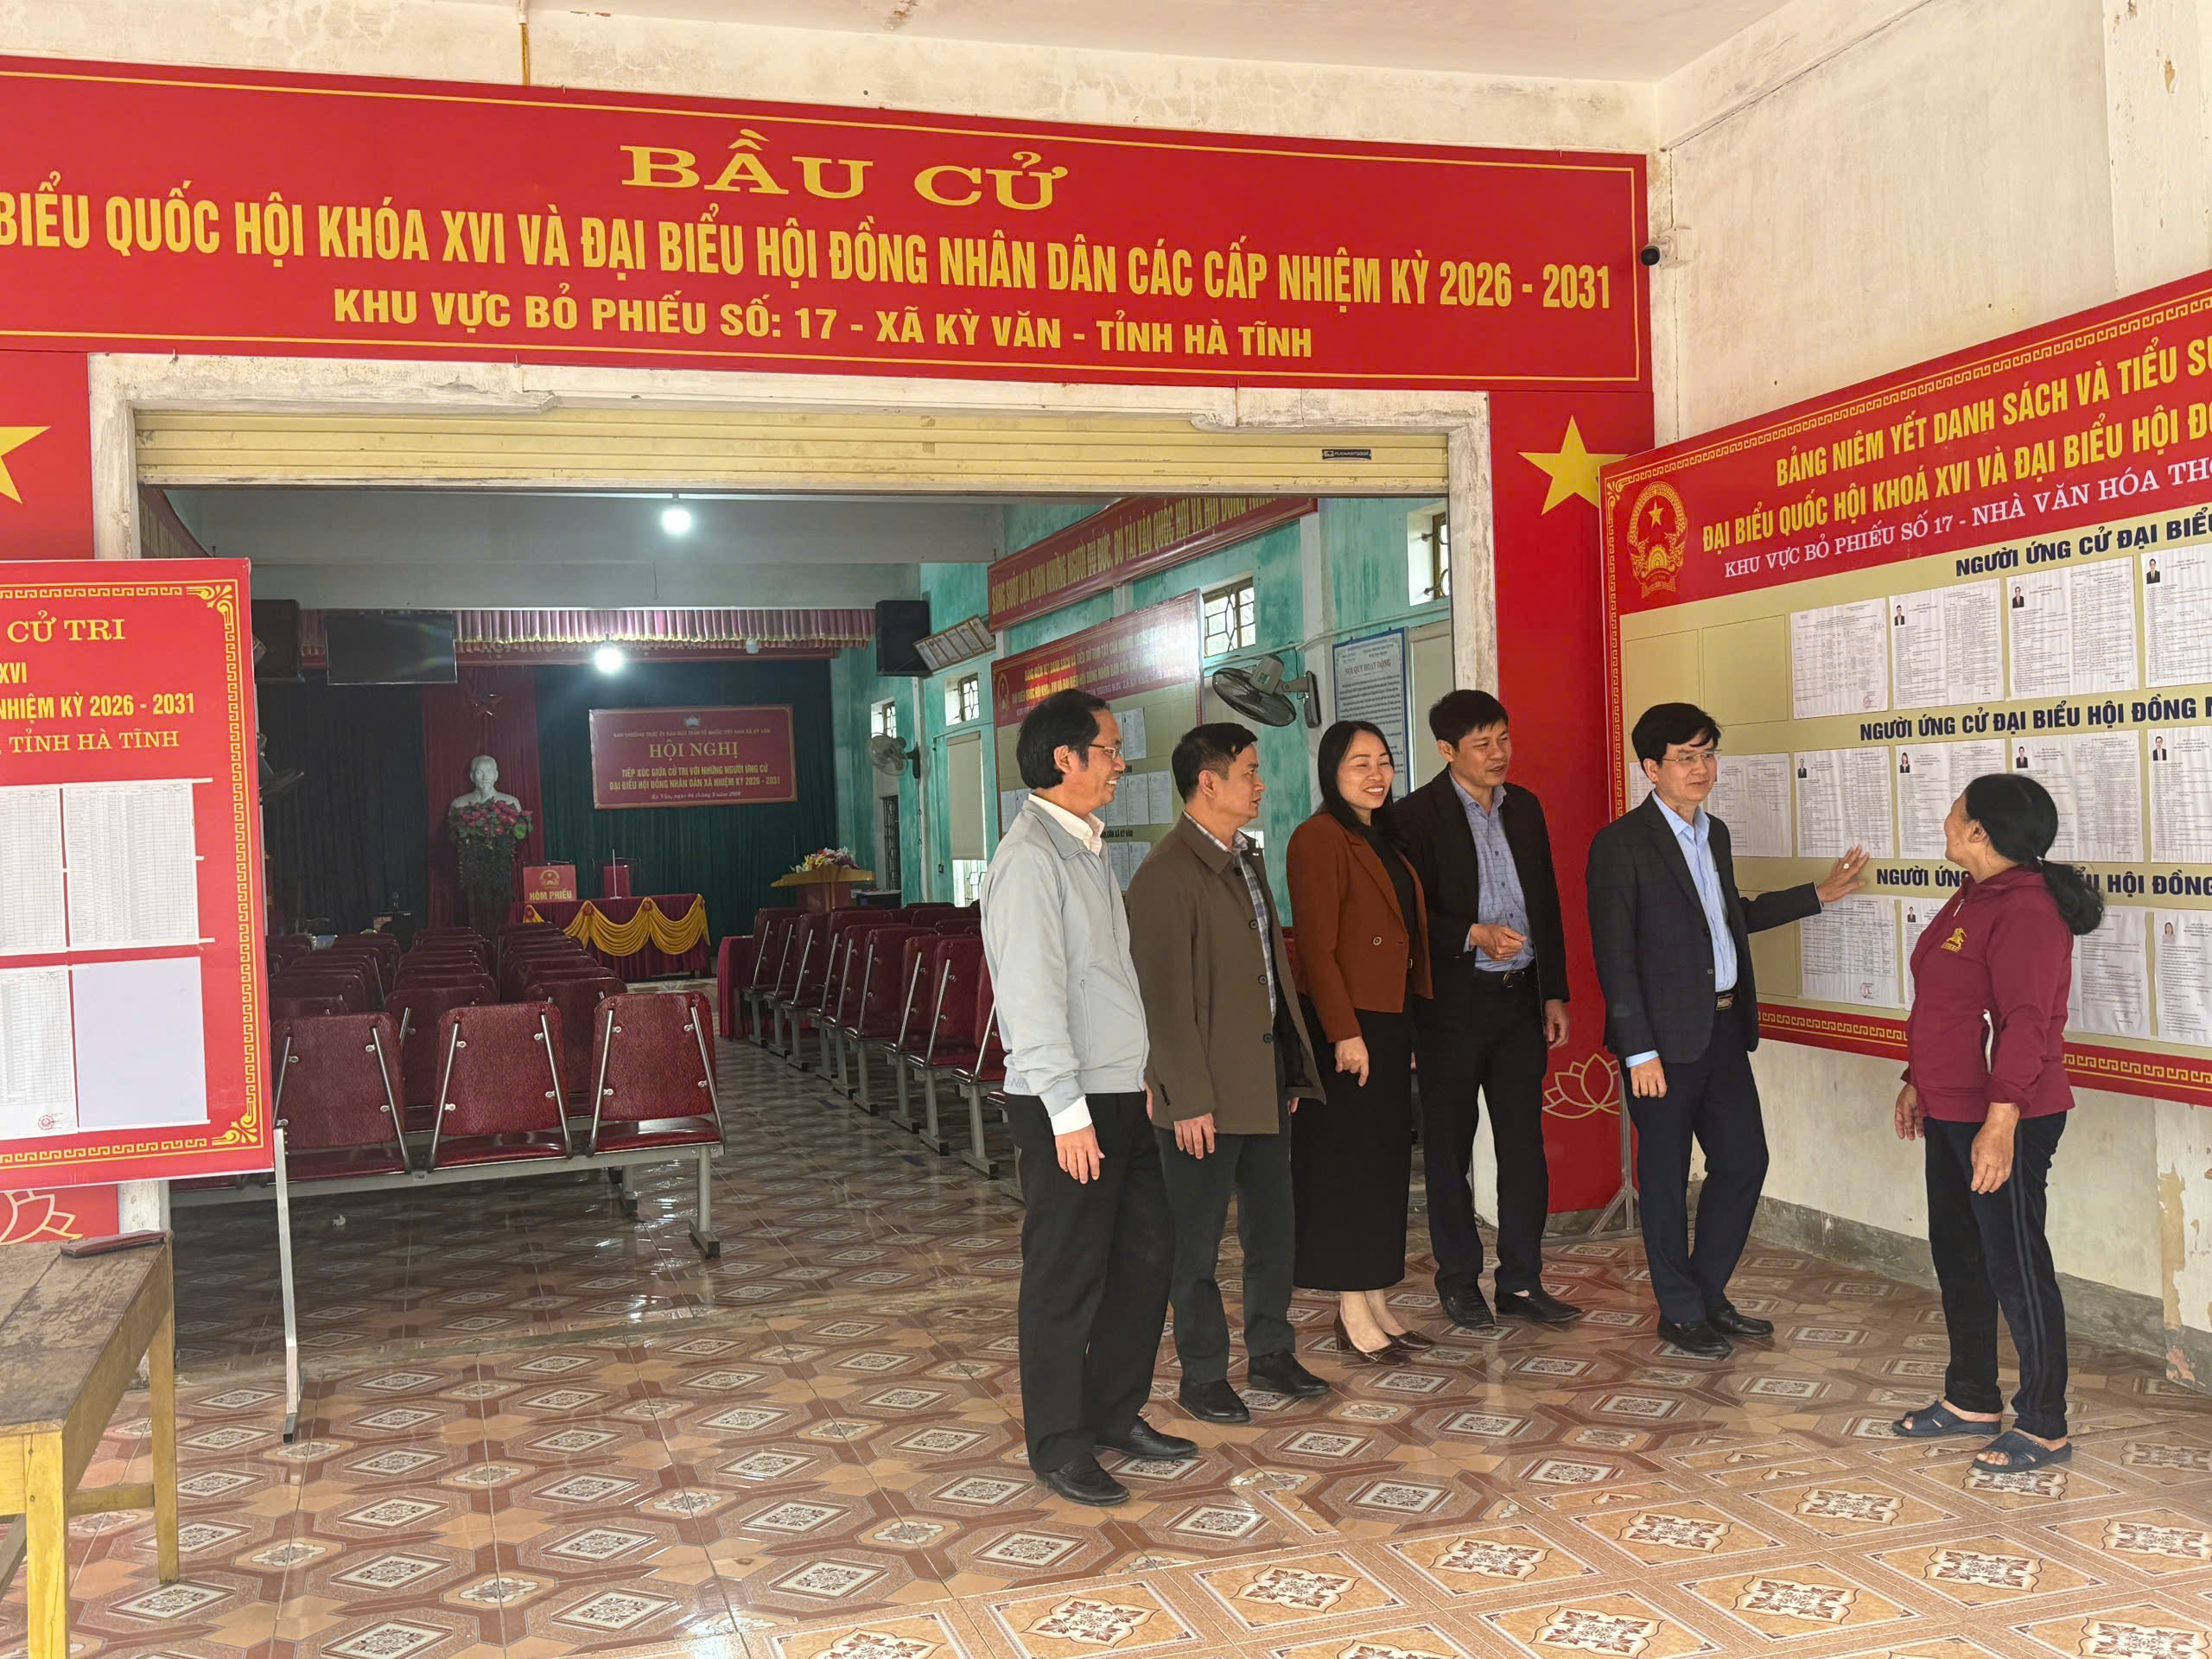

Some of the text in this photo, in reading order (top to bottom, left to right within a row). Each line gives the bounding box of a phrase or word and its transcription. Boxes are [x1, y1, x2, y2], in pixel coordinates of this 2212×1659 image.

[620, 130, 1067, 209] BẦU CỬ
[0, 171, 89, 248] BIỂU
[106, 181, 219, 256] QUỐC
[235, 193, 303, 267] HỘI
[319, 197, 429, 260] KHÓA
[442, 211, 505, 263] XVI
[518, 205, 569, 266] VÀ
[581, 218, 645, 280] ĐẠI
[659, 203, 743, 275] BIỂU
[757, 218, 817, 288] HỘI
[830, 216, 927, 283] ĐỒNG
[940, 230, 1035, 288] NHÂN
[1048, 234, 1116, 292] DÂN
[1128, 238, 1192, 296] CÁC
[1205, 236, 1267, 298] CẤP
[1279, 247, 1380, 312] NHIỆM
[1392, 251, 1428, 303] KỲ
[1440, 261, 1511, 306] 2026
[1544, 264, 1608, 308] 2031
[334, 289, 416, 323] KHU
[431, 290, 510, 333] VỰC
[525, 283, 577, 329] BỎ
[593, 290, 705, 334] PHIẾU
[721, 295, 780, 337] SỐ:
[795, 308, 836, 339] 17
[876, 306, 924, 342] XÃ
[937, 308, 979, 345] KỲ
[992, 311, 1060, 347] VĂN
[1096, 310, 1172, 353] TỈNH
[1185, 320, 1228, 354] HÀ
[1238, 321, 1311, 357] TĨNH
[1777, 336, 2212, 486] BẢNG NIÊM YẾT DANH SÁCH VÀ TIỂU S
[1703, 522, 1729, 554] ĐẠI
[1736, 502, 1773, 543] BIỂU
[1780, 495, 1827, 536] QUỐC
[1834, 483, 1866, 524] HỘI
[1873, 466, 1929, 512] KHOÁ
[1936, 461, 1970, 497] XVI
[1978, 453, 2007, 486] VÀ
[2014, 440, 2055, 482] ĐẠI
[2064, 413, 2122, 468] BIỂU
[2133, 405, 2177, 454] HỘI
[1726, 556, 1759, 577] KHU
[1766, 547, 1799, 568] VỰC
[1805, 534, 1828, 561] BỎ
[1835, 525, 1894, 554] PHIẾU
[1902, 515, 1928, 540] SỐ
[1935, 516, 1953, 533] 17
[1972, 493, 2025, 525] NHÀ
[2033, 477, 2089, 512] VĂN
[2099, 467, 2159, 500] HÓA
[2168, 458, 2212, 485] TH
[1956, 547, 2018, 576] NGƯỜI
[2026, 541, 2070, 563] ỨNG
[2080, 526, 2112, 555] CỬ
[2117, 524, 2157, 549] ĐẠI
[8, 610, 125, 643] CỬ TRI
[60, 691, 83, 717] KỲ
[90, 695, 134, 716] 2026
[153, 693, 194, 715] 2031
[1860, 716, 1912, 741] NGƯỜI
[1919, 714, 1955, 736] ỨNG
[1962, 707, 1989, 733] CỬ
[1993, 712, 2025, 734] ĐẠI
[2033, 701, 2080, 728] BIỂU
[2088, 701, 2124, 728] HỘI
[2132, 694, 2196, 721] ĐỒNG
[9, 728, 179, 753] TỈNH HÀ TĨNH
[650, 740, 739, 760] HỘI NGHỊ
[1877, 866, 1929, 886] NGƯỜI
[2107, 871, 2144, 897] HỘI
